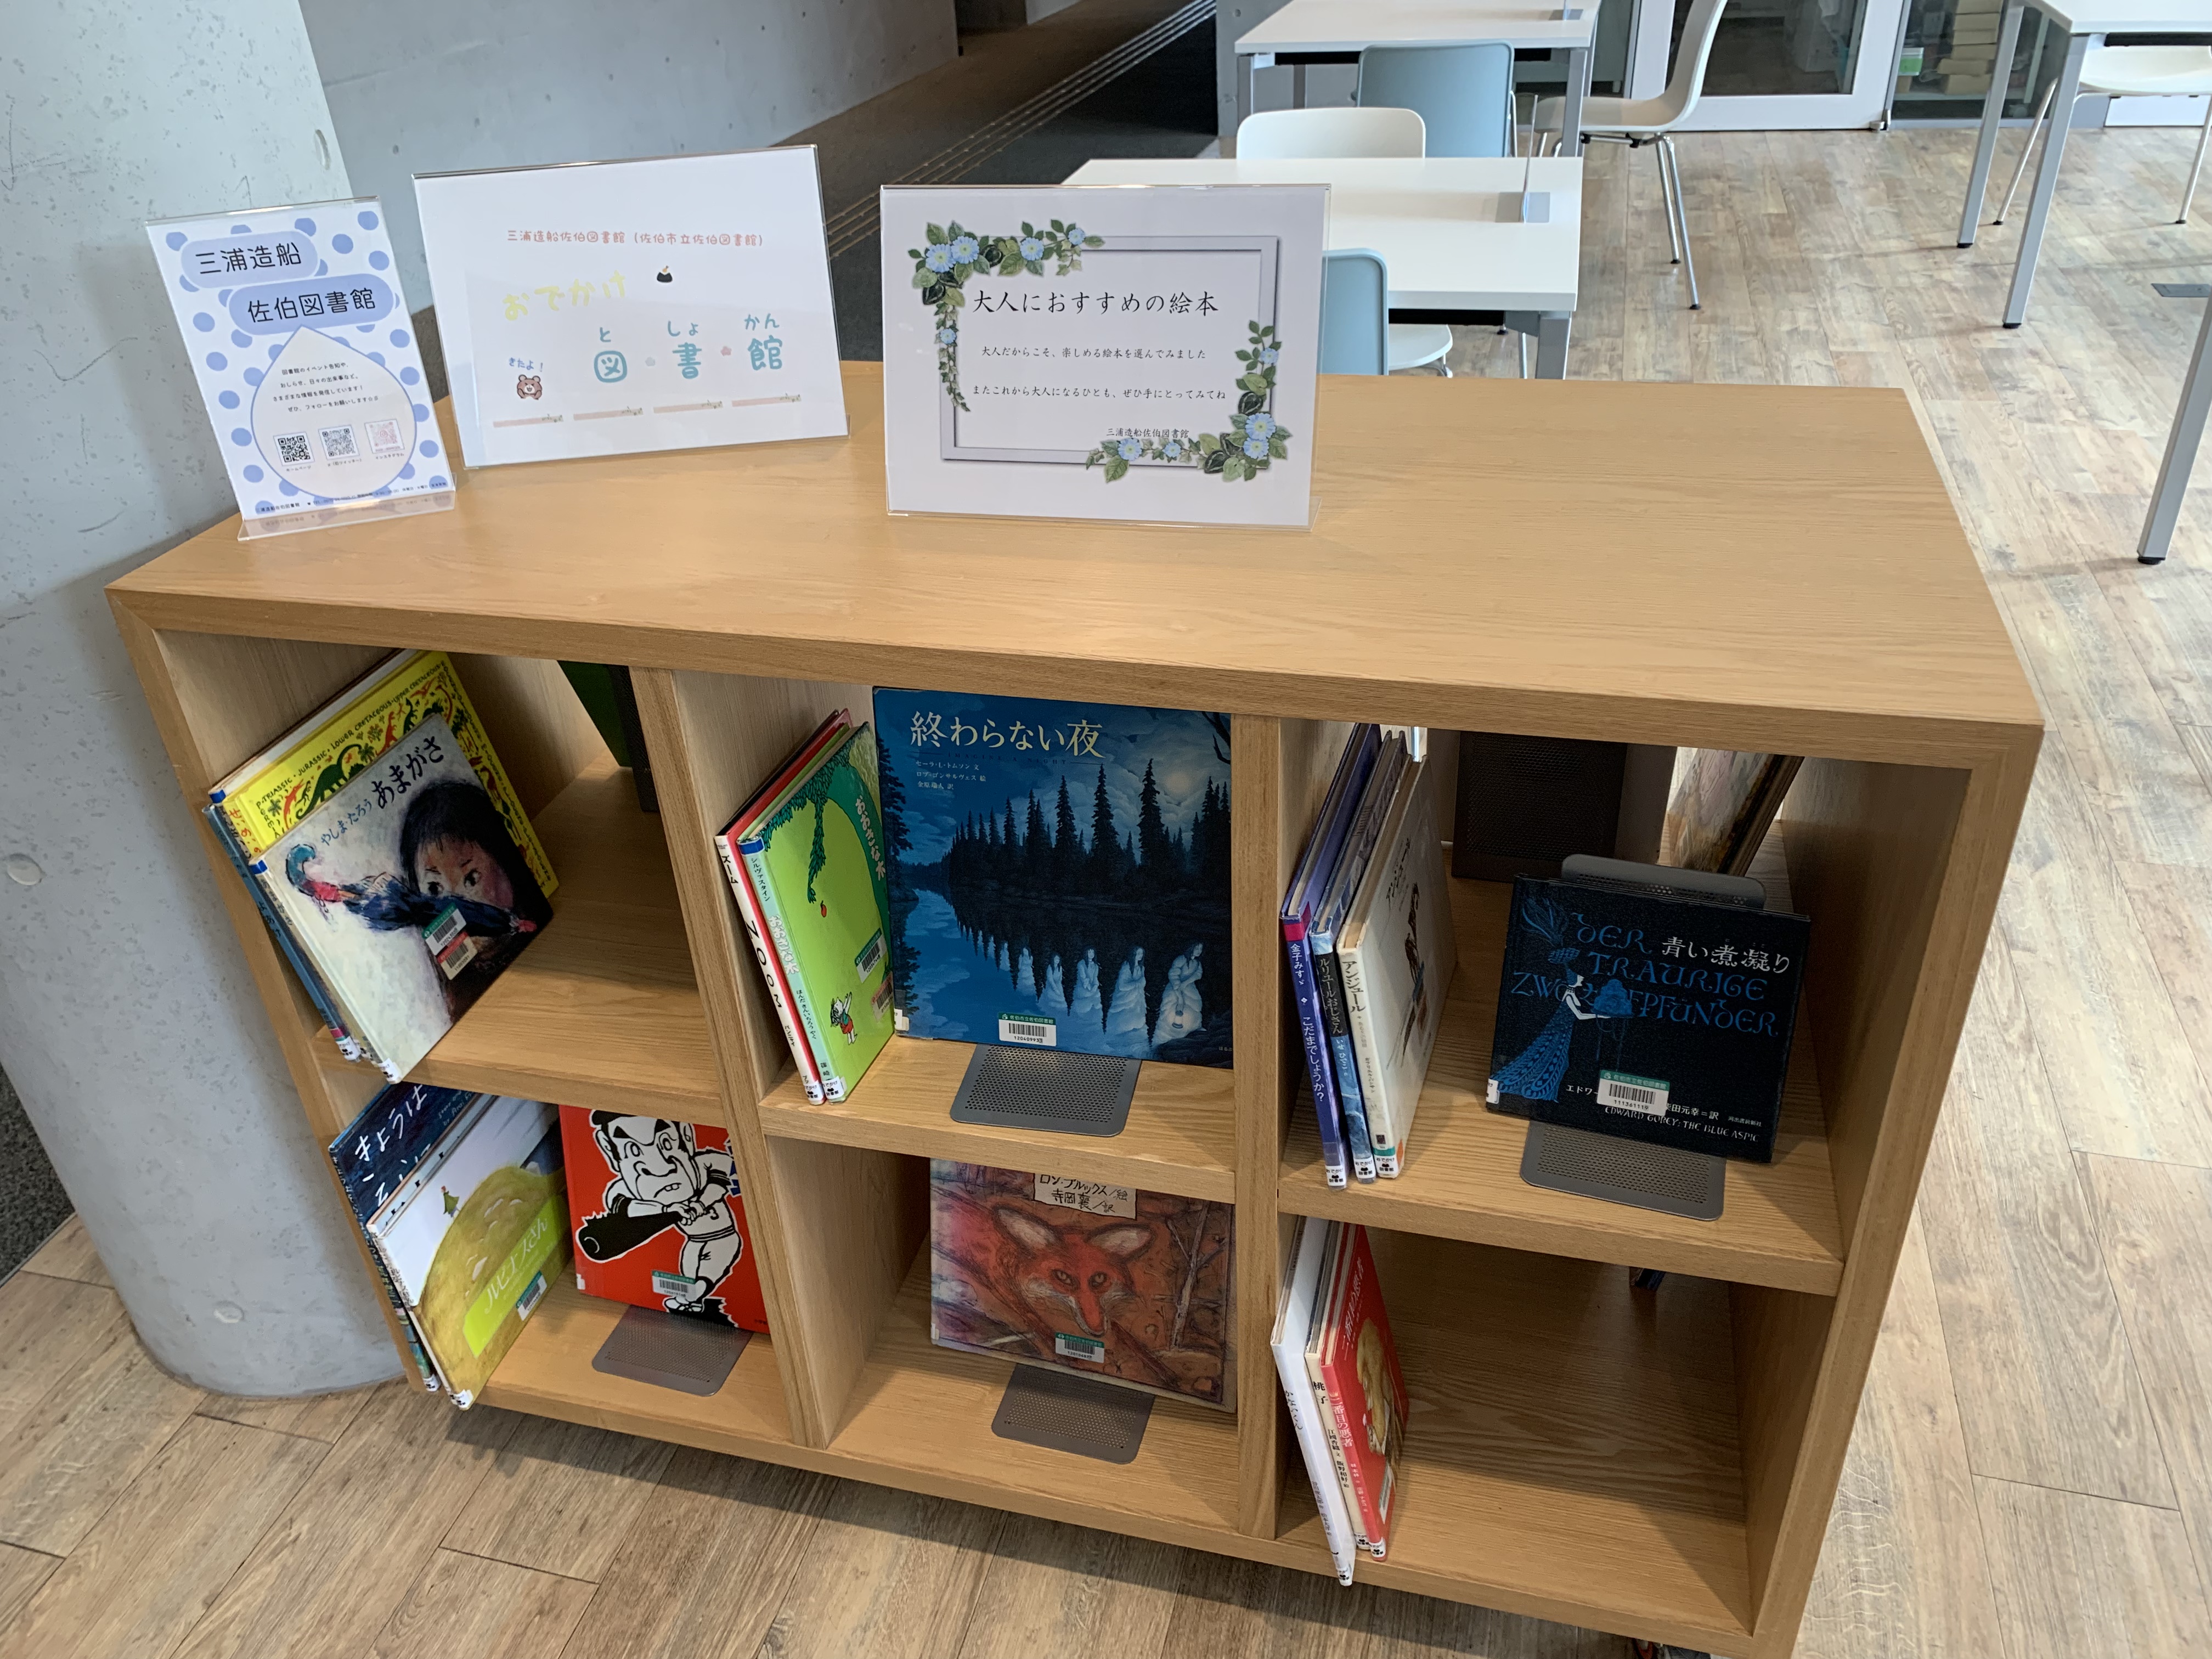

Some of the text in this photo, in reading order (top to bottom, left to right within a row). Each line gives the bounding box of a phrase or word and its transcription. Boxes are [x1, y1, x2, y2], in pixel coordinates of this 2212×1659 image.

[195, 241, 302, 275] 三浦造船
[247, 287, 376, 324] 佐伯図書館
[502, 270, 627, 321] おでかけ
[972, 290, 1219, 317] 大人におすすめの絵本
[600, 313, 780, 343] と しょ かん
[981, 346, 1206, 360] 大人だからこそ、楽しめる絵本を選んでみました
[972, 385, 1227, 400] またこれから大人になるひとも、ぜひ手にとってみてね
[1105, 426, 1190, 439] 三浦造船佐伯図書館
[910, 710, 1105, 759] 終わらない夜
[371, 736, 444, 809] あまがさ
[855, 795, 887, 881] おおきな木
[721, 854, 739, 884] ズーム
[751, 857, 771, 902] シルヴァスタイン
[768, 915, 799, 975] おおきな木
[1570, 912, 1652, 955] DER
[745, 920, 782, 1008] ZOOM
[1661, 936, 1790, 974] 青い煮凝り
[1342, 960, 1367, 1013] アンジュール
[1589, 951, 1769, 1001] TRAURIGE
[820, 1062, 833, 1081] 篠崎
[354, 1084, 427, 1161] きょうは
[1703, 1124, 1730, 1137] BLUE
[1313, 1381, 1329, 1404] 桃子
